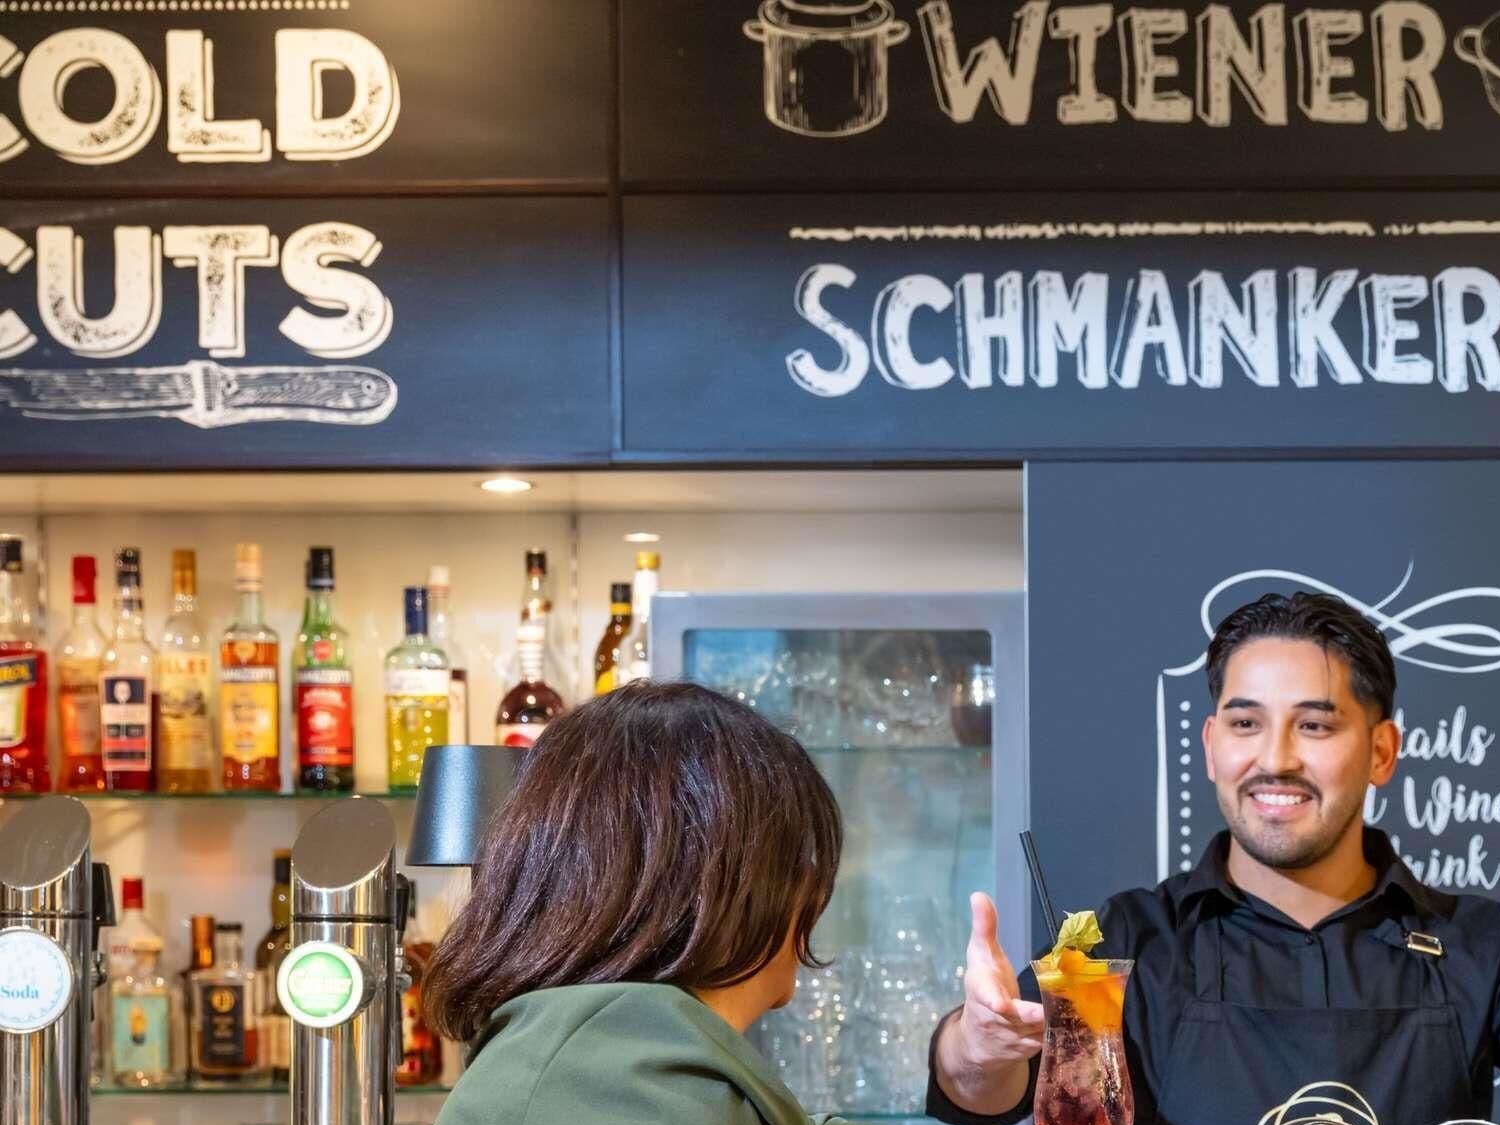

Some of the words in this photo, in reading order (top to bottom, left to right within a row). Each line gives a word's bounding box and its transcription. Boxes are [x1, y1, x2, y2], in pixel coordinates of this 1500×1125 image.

[0, 27, 400, 165] OLD
[915, 0, 1445, 132] WIENER
[1393, 704, 1496, 767] tails
[0, 985, 40, 1000] Soda
